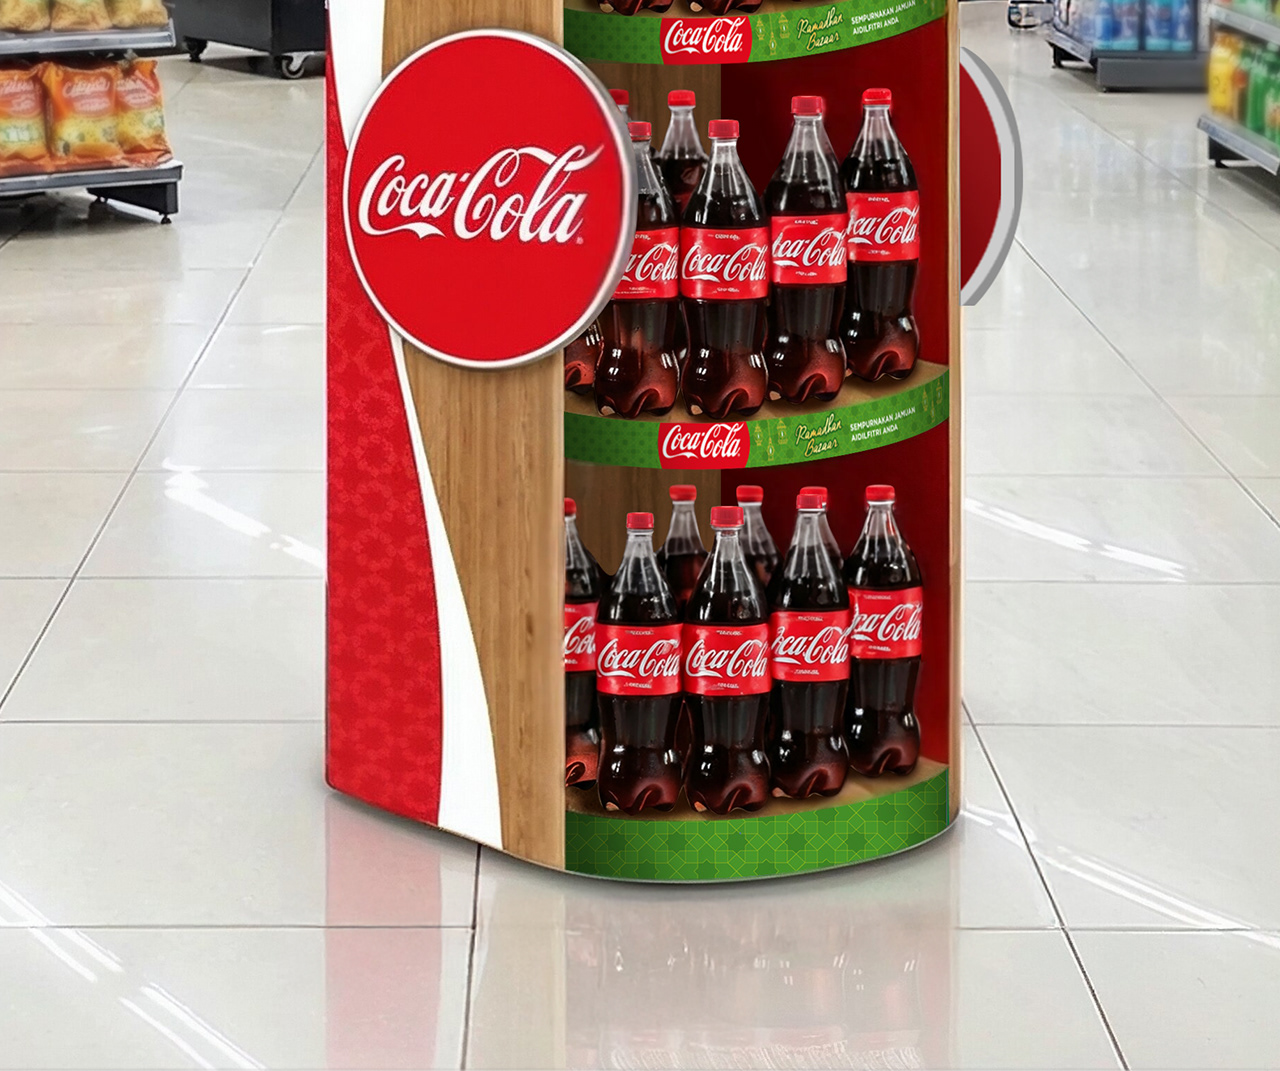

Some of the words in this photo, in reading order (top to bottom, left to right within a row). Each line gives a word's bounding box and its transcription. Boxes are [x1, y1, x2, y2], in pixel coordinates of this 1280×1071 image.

[797, 7, 844, 39] Ramadhan
[850, 6, 894, 25] SEMPURNAKAN
[894, 0, 916, 13] JAMUAN
[852, 20, 883, 35] AIDILFITRI
[883, 16, 899, 27] ANDA
[664, 17, 746, 54] Coca-Cola
[806, 32, 840, 51] Bazaar
[358, 144, 605, 244] Coca-Cola
[846, 205, 919, 245] ca-Cola
[621, 242, 679, 282] a-Cola
[795, 413, 842, 445] Ramadhan
[849, 414, 894, 432] SEMPURNAKAN
[894, 406, 916, 421] JAMUAN
[851, 428, 882, 442] AIDILFITRI
[882, 424, 898, 435] ANDA
[662, 422, 744, 459] Coca-Cola
[804, 438, 838, 457] Bazaar
[851, 603, 922, 642] ca-Cola
